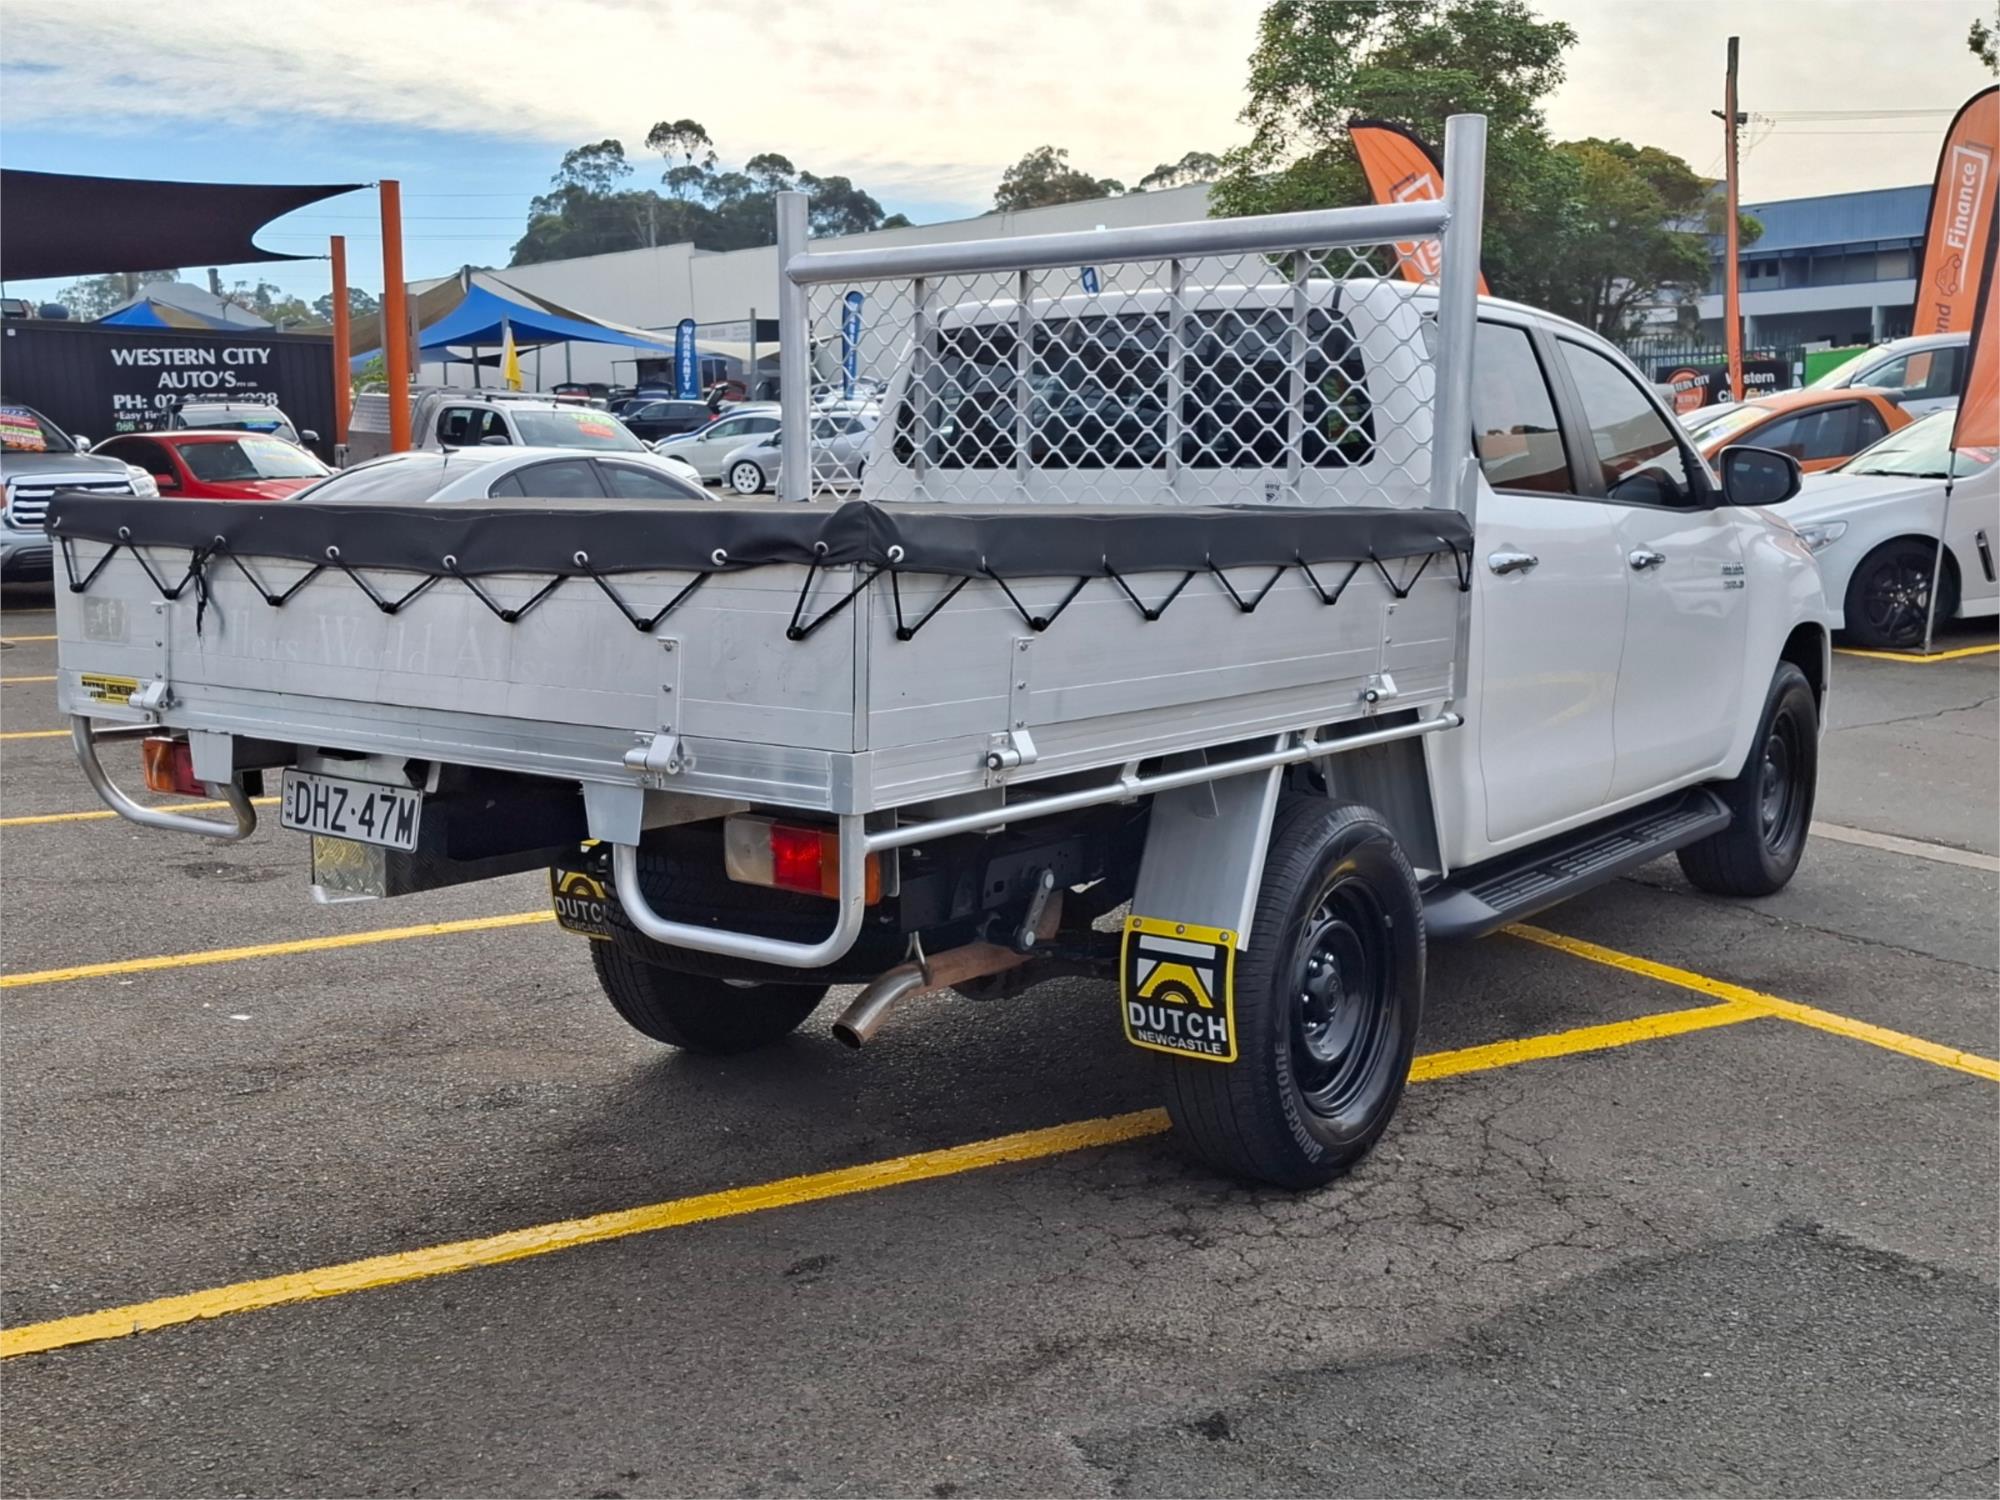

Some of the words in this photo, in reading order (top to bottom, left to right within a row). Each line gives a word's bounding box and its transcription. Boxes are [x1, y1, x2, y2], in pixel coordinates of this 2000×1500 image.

[1947, 162, 1977, 249] Finance
[111, 348, 216, 366] WESTERN
[222, 347, 271, 365] CITY
[157, 370, 237, 389] AUTO'S
[1725, 371, 1775, 385] Wstern
[113, 394, 148, 409] PH:
[119, 410, 142, 421] Easy
[555, 895, 607, 923] DUTC
[1128, 1001, 1228, 1042] DUTCH
[1137, 1029, 1223, 1056] NEWCASTLE
[1274, 1041, 1324, 1164] BRIDGESTONE
